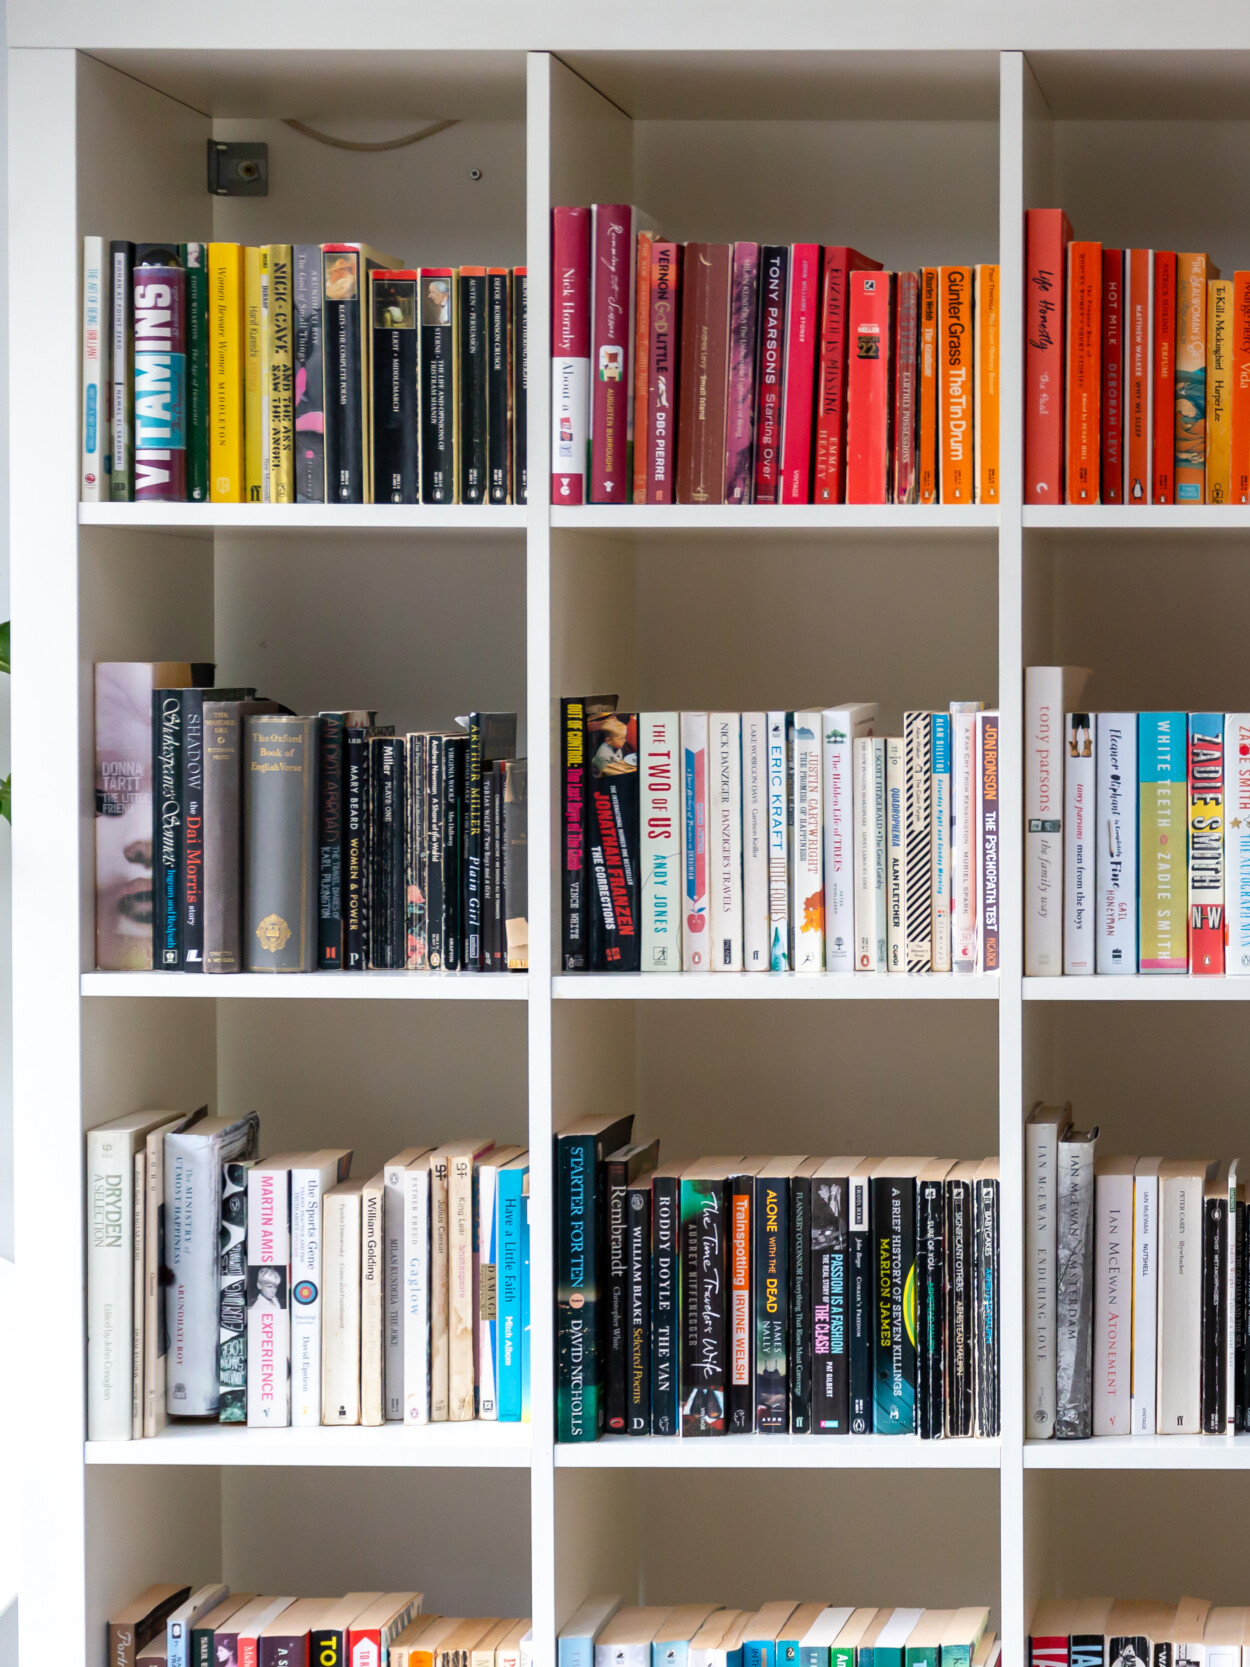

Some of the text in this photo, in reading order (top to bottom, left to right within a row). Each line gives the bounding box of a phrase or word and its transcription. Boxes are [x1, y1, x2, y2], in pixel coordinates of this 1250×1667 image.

[217, 267, 226, 300] Women
[217, 304, 226, 337] Beware
[275, 263, 287, 354] NICK CAVE
[559, 268, 575, 350] Nick Hornby
[135, 284, 171, 489] VITAMINS
[217, 341, 226, 374] Women
[761, 257, 780, 480] TONY PARSONS Starting Over
[282, 365, 291, 451] AND THE ASS
[606, 389, 614, 472] AUGUSTEN BURROUGHS
[655, 412, 666, 481] DBC PIERRE
[102, 761, 143, 776] DONNA
[186, 714, 200, 790] SHADOW
[470, 725, 481, 836] ARTHUR MILLER
[647, 724, 671, 839] THE TWO OF US
[1036, 706, 1050, 812] tony parsons
[1158, 720, 1170, 828] WHITE TEETH
[770, 746, 782, 850] ERIC KRAFT
[186, 801, 201, 926] the Dai Morris story
[653, 854, 668, 933] ANDY JONES
[892, 883, 900, 927] FLETCHER
[1158, 852, 1170, 960] ZADIE SMITH
[104, 1174, 122, 1248] DRYDEN
[174, 1157, 183, 1265] UTMOST HAPPINESS
[261, 1176, 273, 1263] MARTIN AMIS
[365, 1197, 377, 1280] William Golding
[570, 1147, 583, 1288] STARTER FOR TEN
[611, 1185, 628, 1277] Rembrandt
[733, 1200, 748, 1286] Trainspotting
[1036, 1145, 1047, 1361] IAN McEWAN ENDURING LOVE
[504, 1316, 513, 1366] Mitch Albom
[774, 1320, 782, 1353] JAMES
[1107, 1209, 1121, 1397] IAN McEWAN ATONEMENT
[261, 1313, 273, 1401] EXPERIENCE
[570, 1319, 583, 1436] DAVID NICHOLLS
